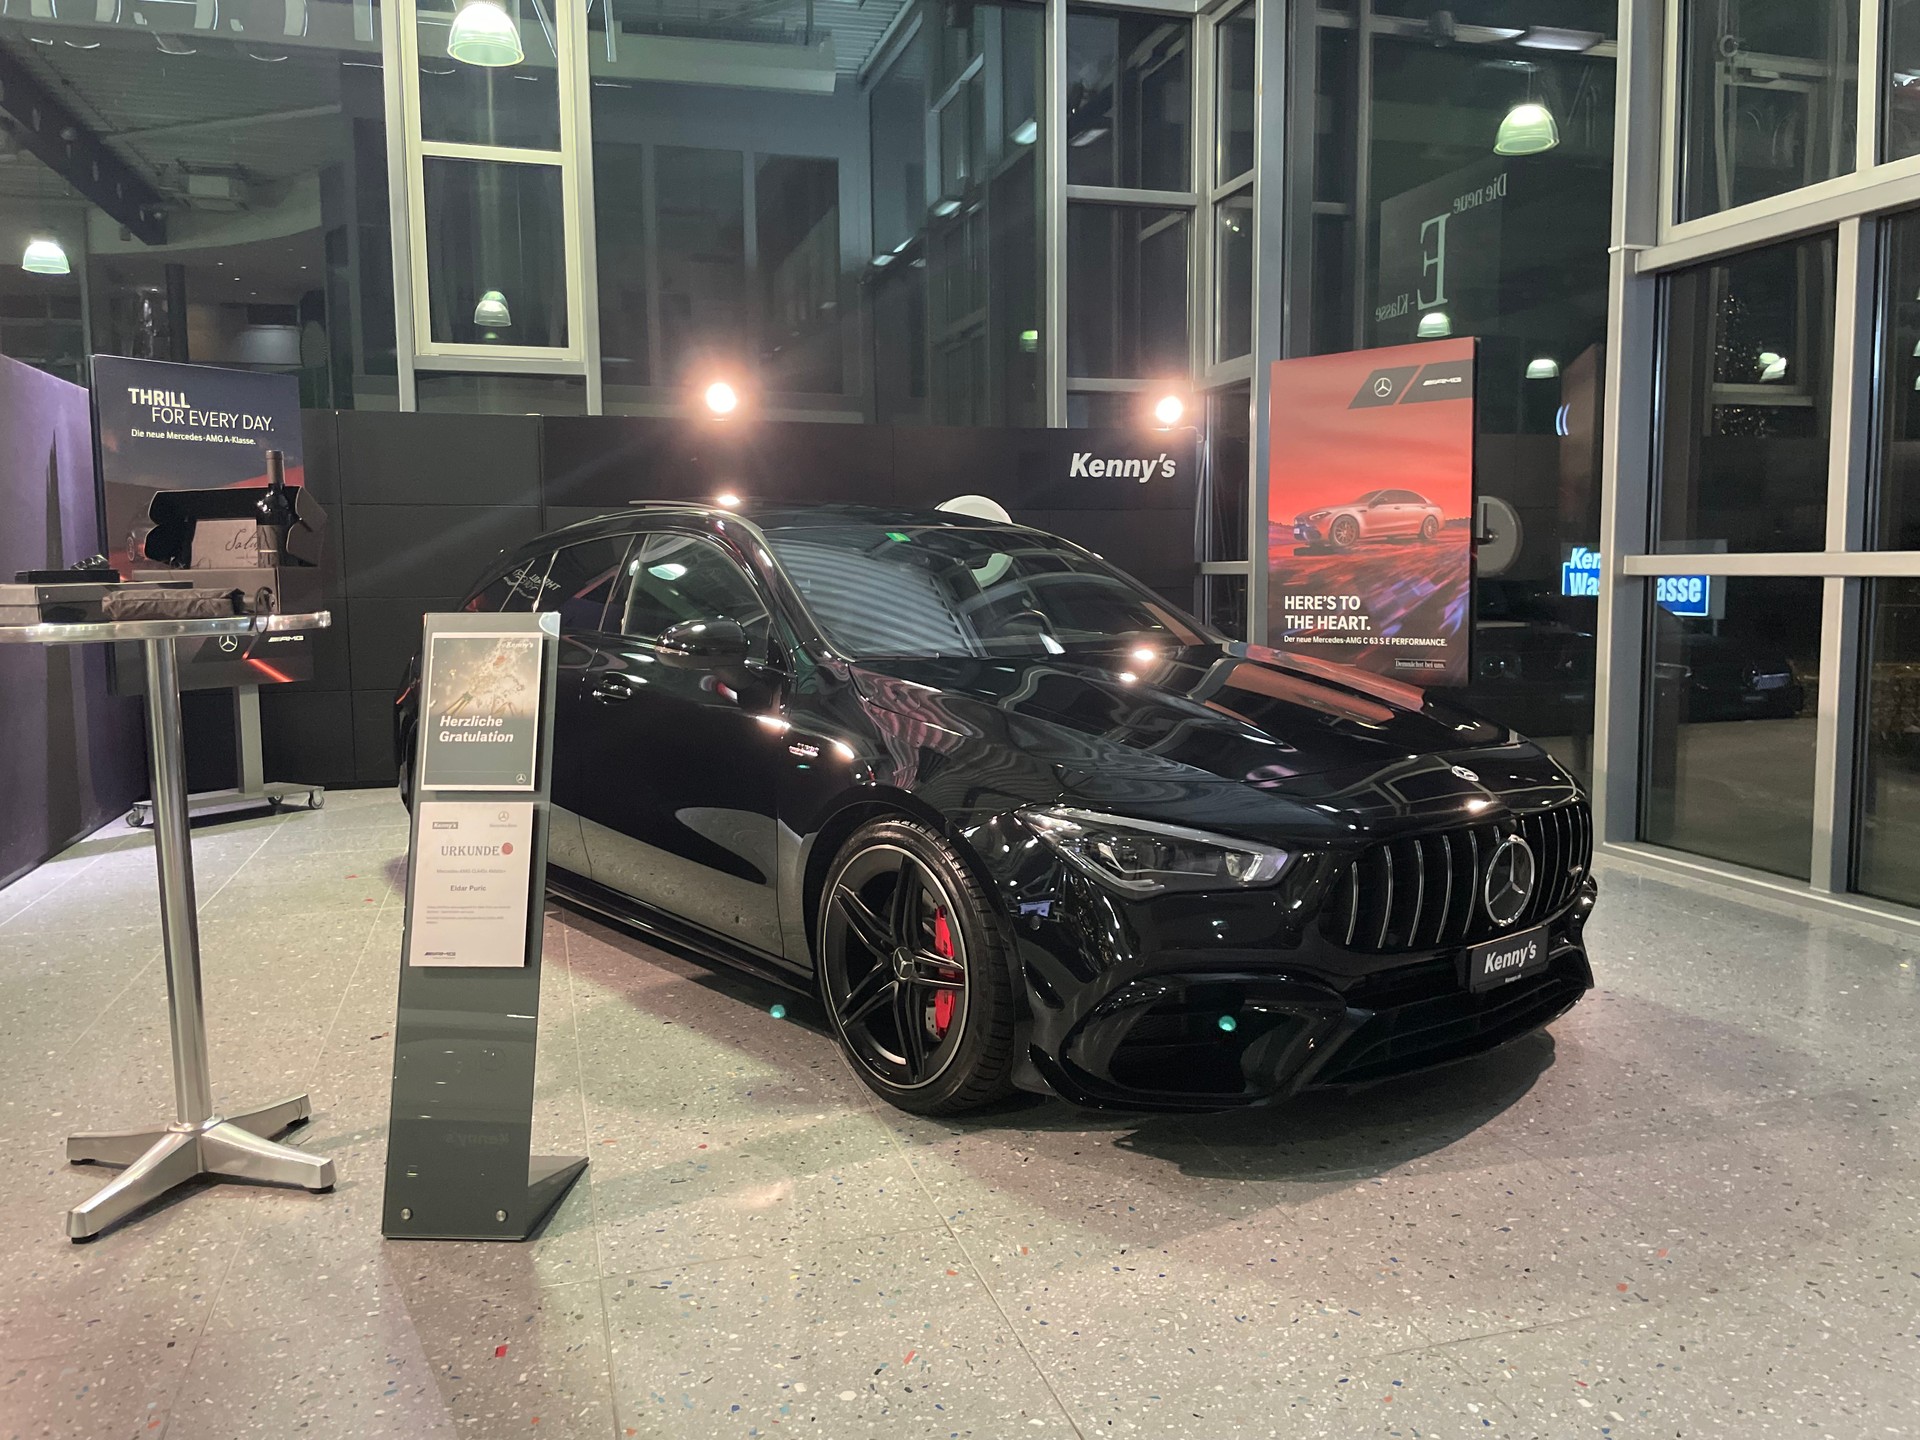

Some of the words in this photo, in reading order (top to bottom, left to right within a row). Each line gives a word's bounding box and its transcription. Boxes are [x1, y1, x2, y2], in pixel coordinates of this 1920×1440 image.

[128, 387, 191, 409] THRILL
[152, 406, 185, 425] FOR
[189, 410, 239, 429] EVERY
[243, 414, 275, 432] DAY.
[131, 429, 145, 437] Die
[146, 431, 165, 439] neue
[167, 432, 223, 443] Mercedes-AMG
[224, 436, 256, 445] A-Klasse.
[1069, 452, 1177, 484] Kenny's
[1570, 547, 1601, 570] Ken
[1569, 572, 1600, 596] Wa
[1656, 577, 1702, 603] asse
[1284, 595, 1337, 611] HERE'S
[1339, 595, 1361, 611] TO
[1284, 615, 1314, 630] THE
[1317, 615, 1371, 631] HEART.
[1284, 635, 1295, 643] Der
[1312, 636, 1362, 644] Mercedes-AMG
[1363, 637, 1368, 645] C
[1369, 637, 1379, 645] 63
[1379, 637, 1385, 645] S
[1385, 637, 1391, 645] E
[1391, 637, 1448, 647] PERFORMANCE.
[439, 715, 503, 727] Herzliche
[439, 731, 514, 742] Gratulation
[441, 846, 500, 856] URKUNDE
[1484, 940, 1537, 974] Kenny's
